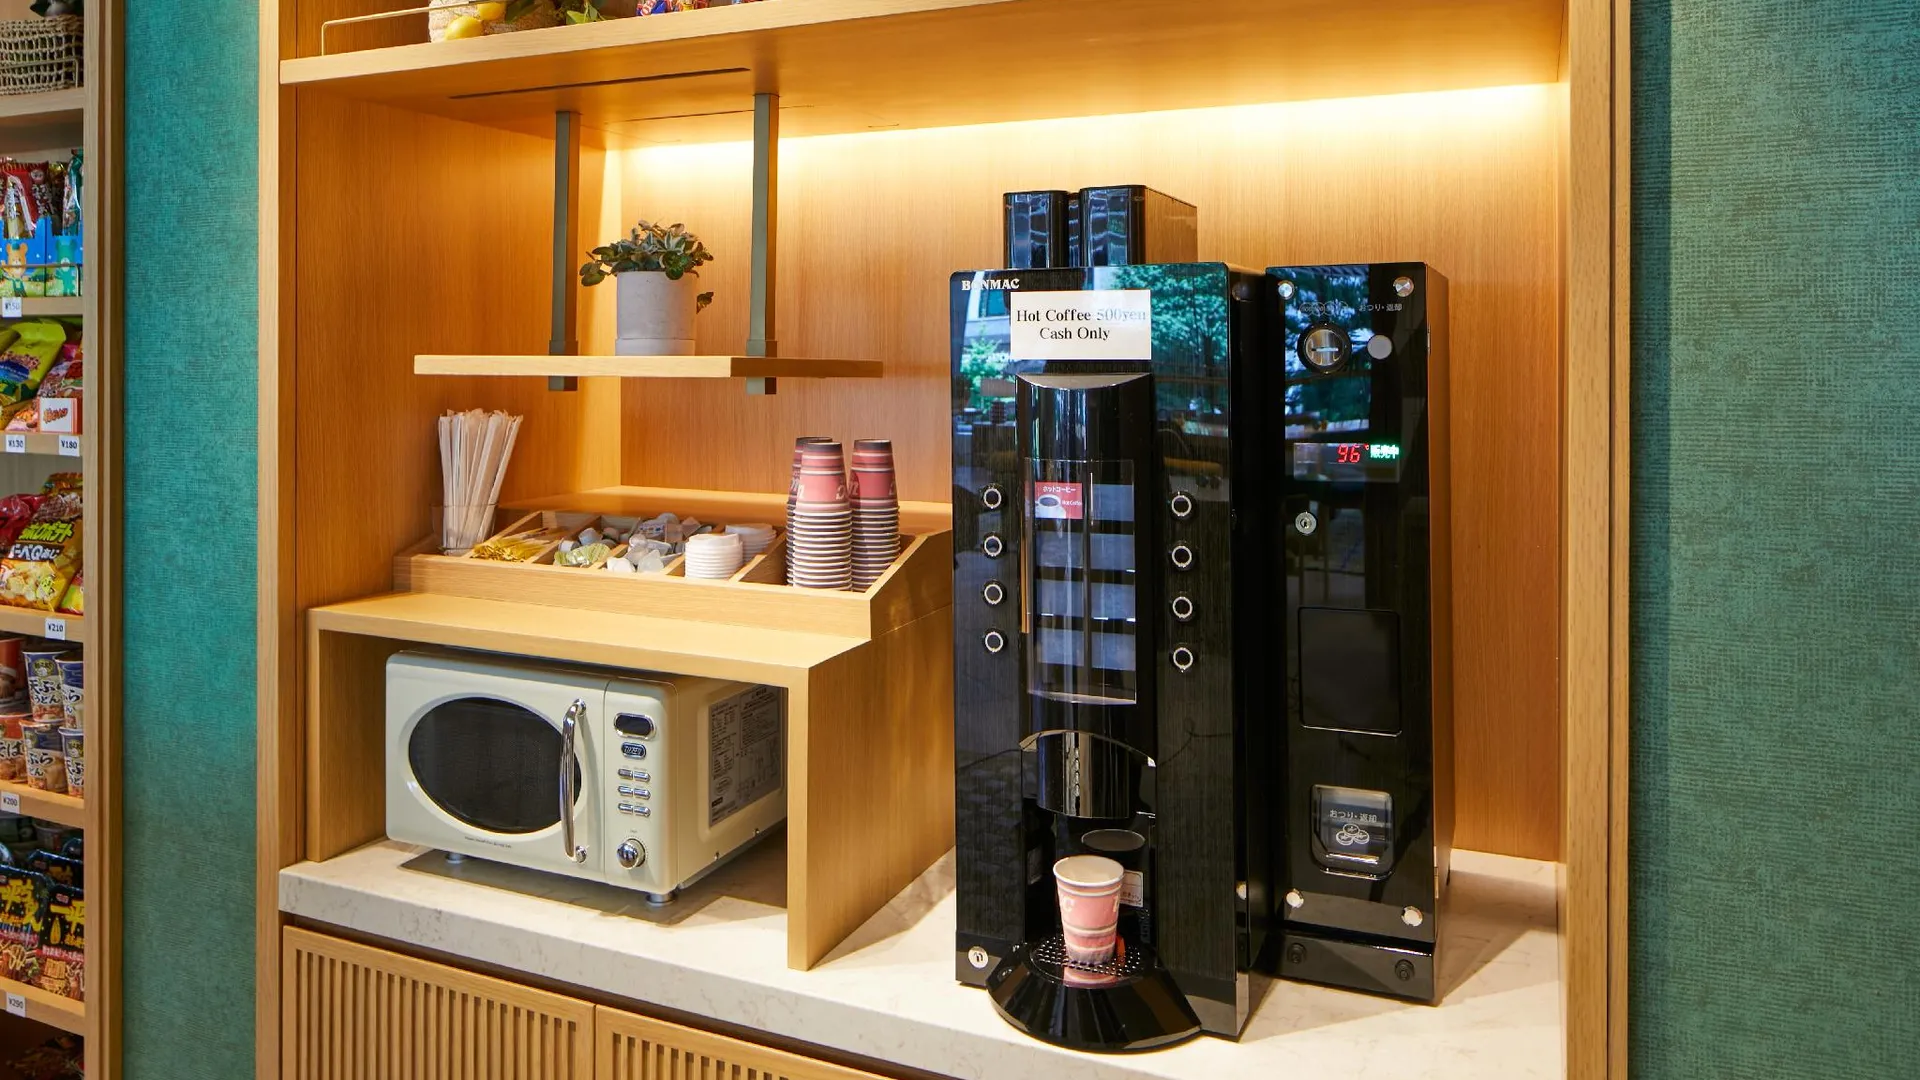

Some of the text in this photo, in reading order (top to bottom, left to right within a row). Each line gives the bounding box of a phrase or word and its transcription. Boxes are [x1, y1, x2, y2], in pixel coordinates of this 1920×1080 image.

[961, 278, 1020, 291] BONMAC
[1016, 308, 1146, 323] Hot Coffee 500yen
[1039, 326, 1110, 341] Cash Only
[1337, 443, 1360, 463] 96
[1042, 485, 1077, 493] ホットコーヒー
[1328, 808, 1378, 824] おつり・返却
